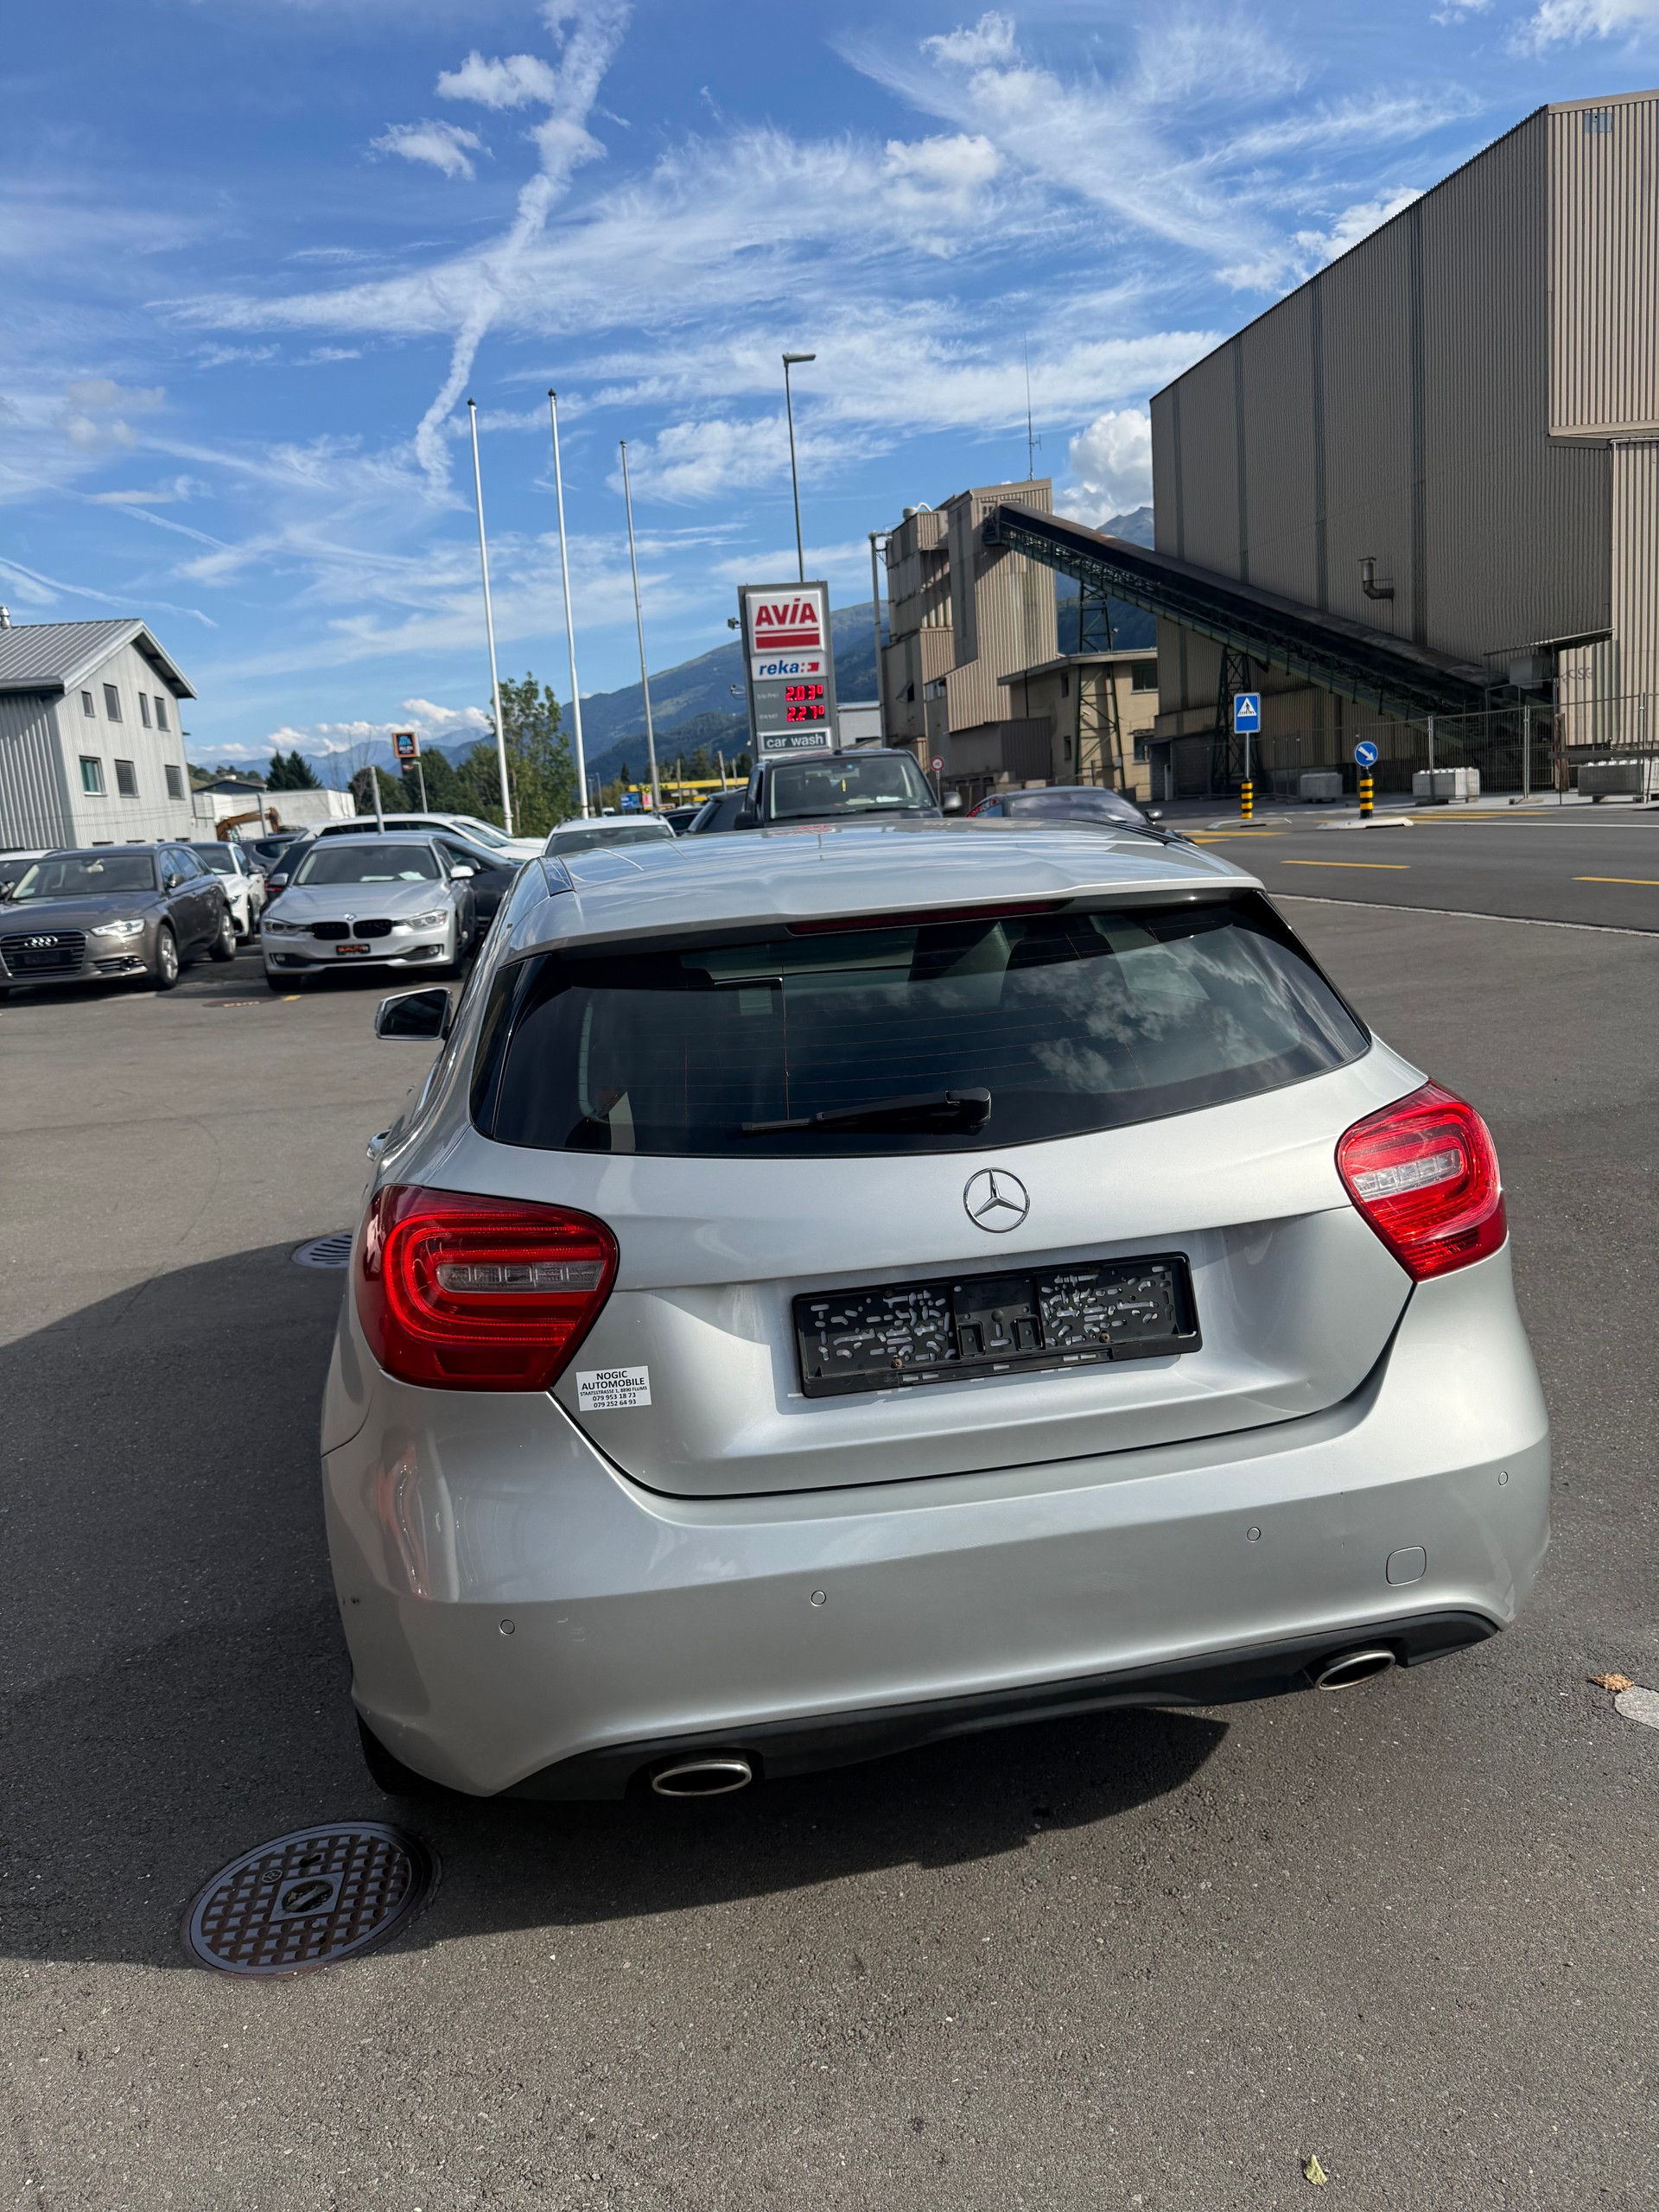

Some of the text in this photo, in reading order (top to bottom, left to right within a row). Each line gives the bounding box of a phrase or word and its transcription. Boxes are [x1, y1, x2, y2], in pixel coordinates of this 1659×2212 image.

[755, 598, 817, 626] AVIA
[766, 734, 824, 748] car wash
[596, 1370, 627, 1381] NOGIC
[582, 1377, 645, 1390] AUTOMOBILE
